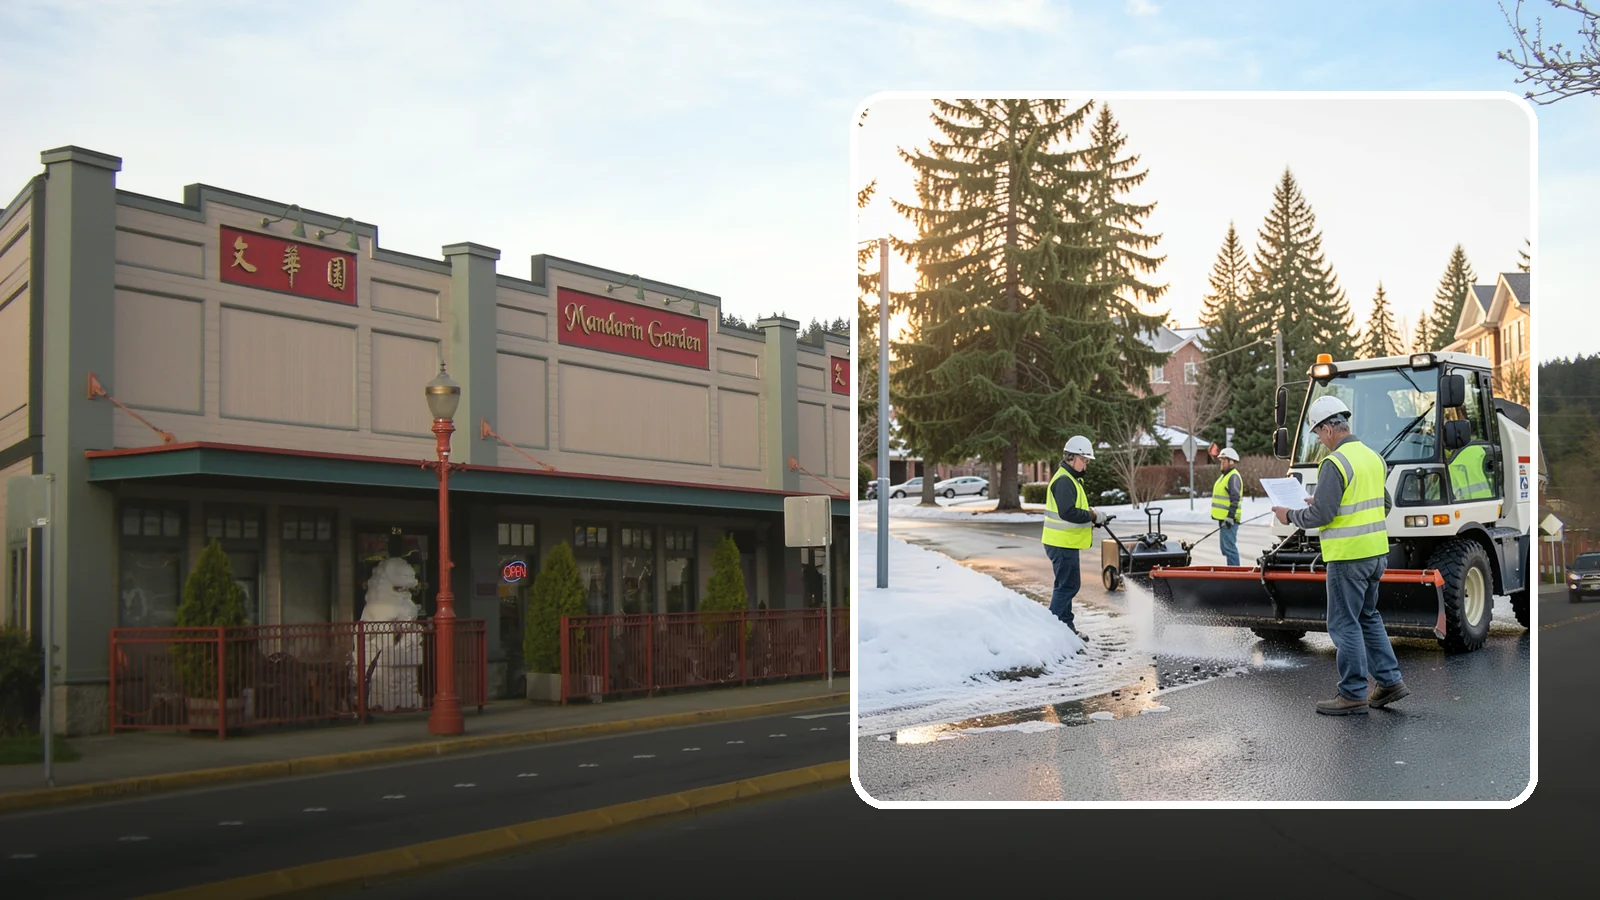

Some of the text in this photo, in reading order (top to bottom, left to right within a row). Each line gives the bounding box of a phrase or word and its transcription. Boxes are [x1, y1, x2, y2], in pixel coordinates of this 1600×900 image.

[231, 235, 346, 291] 文華園
[564, 302, 701, 352] Mandarin Garden
[503, 565, 527, 578] OPEN
